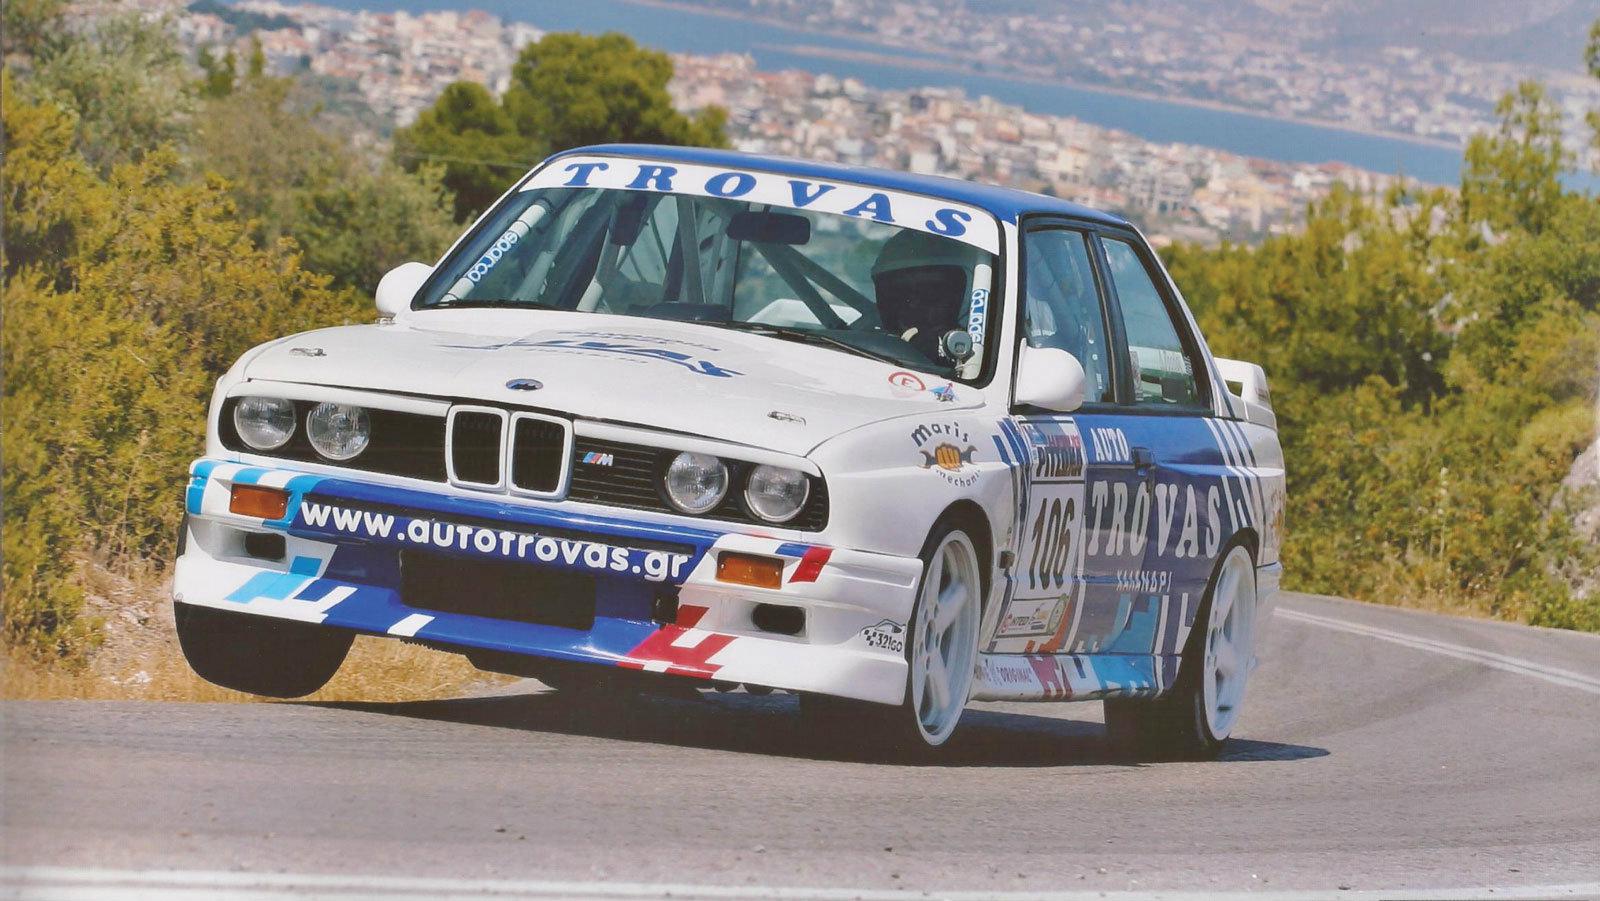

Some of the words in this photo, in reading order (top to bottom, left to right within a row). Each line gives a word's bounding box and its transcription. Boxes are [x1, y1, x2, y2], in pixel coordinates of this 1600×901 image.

[563, 162, 972, 237] TROVAS
[467, 230, 519, 282] sparco
[911, 421, 969, 447] maris
[1090, 427, 1129, 462] AUTO
[301, 502, 691, 582] www.autotrovas.gr
[1029, 498, 1075, 590] 106
[1087, 480, 1221, 559] TROVAS
